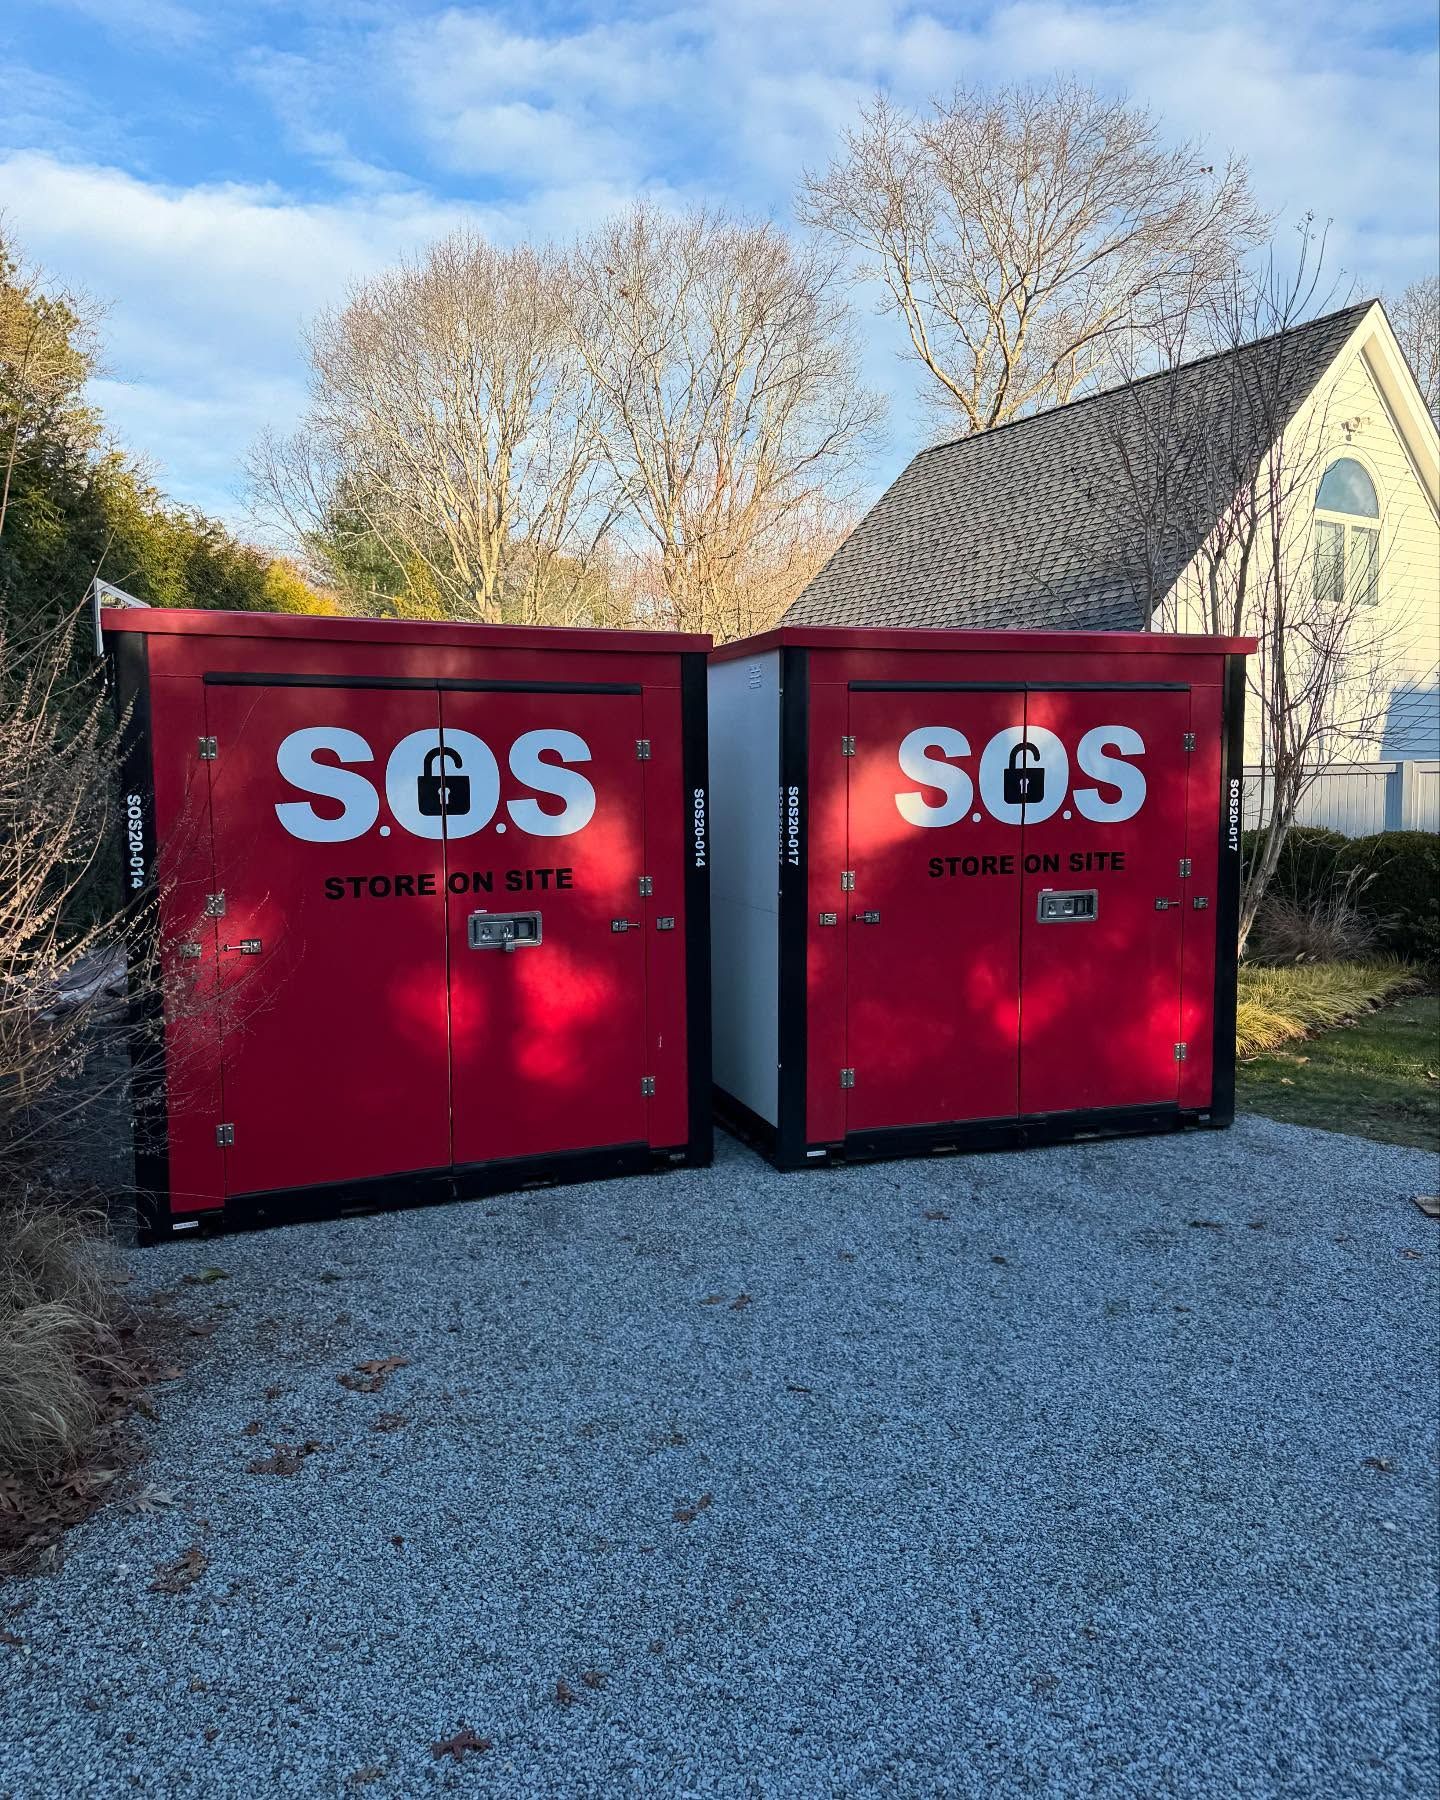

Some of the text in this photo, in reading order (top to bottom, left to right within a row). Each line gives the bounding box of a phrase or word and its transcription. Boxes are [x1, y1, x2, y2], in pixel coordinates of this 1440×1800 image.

[274, 726, 596, 843] S.O.S
[895, 725, 1147, 828] S.O.S
[1228, 779, 1240, 852] SOS20-017
[127, 794, 145, 889] SOS20-014
[694, 788, 706, 868] SOS20-014
[788, 786, 799, 866] SOS20-017
[928, 852, 1126, 878] STORE ON SITE
[324, 868, 574, 900] STORE ON SITE
